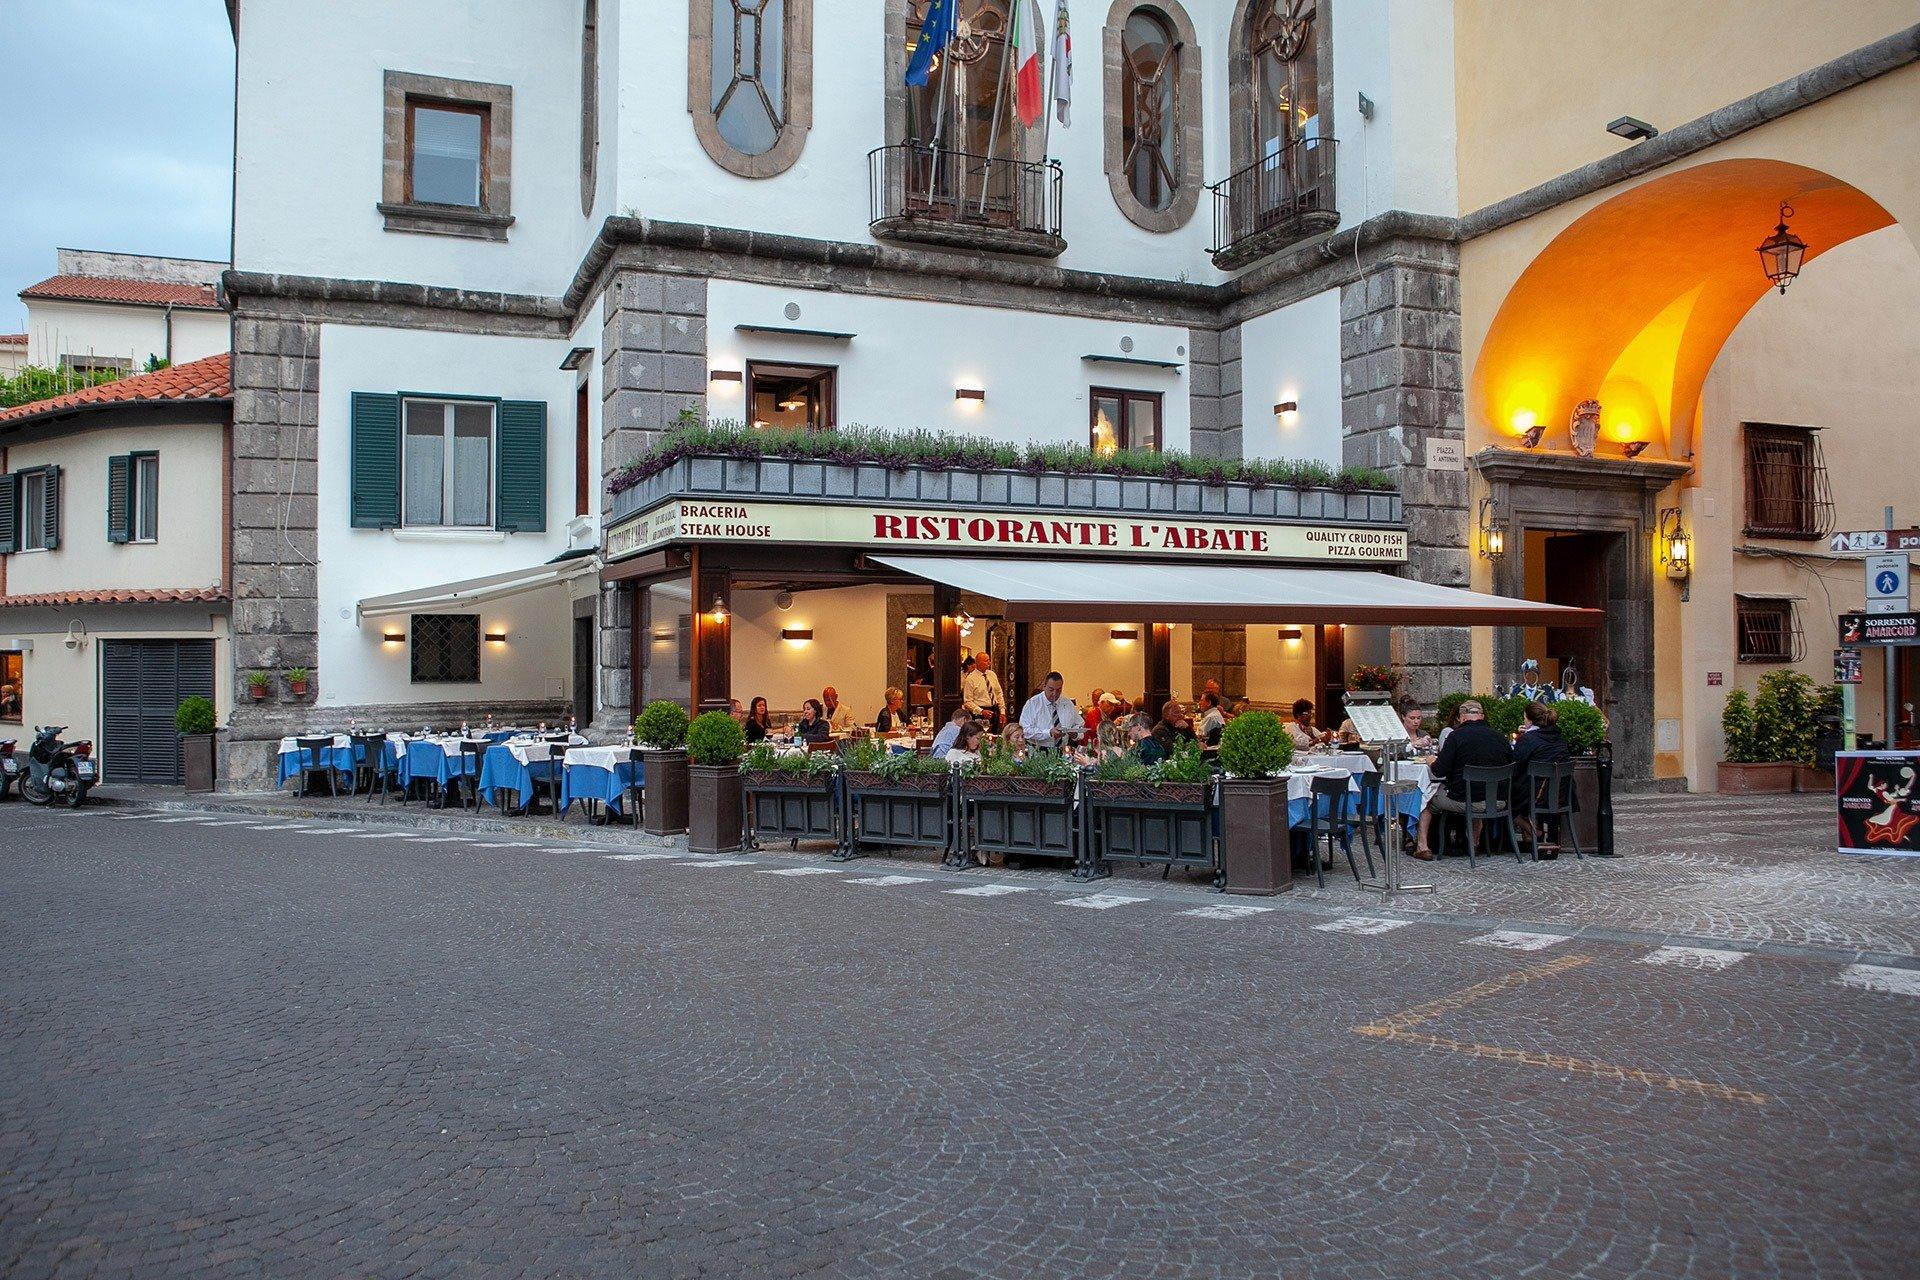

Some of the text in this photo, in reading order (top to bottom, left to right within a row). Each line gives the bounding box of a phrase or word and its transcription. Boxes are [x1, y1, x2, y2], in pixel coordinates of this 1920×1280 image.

[1436, 446, 1455, 454] PIAZZA
[681, 505, 748, 518] BRACERIA
[681, 523, 721, 536] STEAK
[725, 524, 771, 537] HOUSE
[873, 514, 1269, 552] RISTORANTE L'ABATE
[1306, 531, 1403, 545] QUALITY CRUDO FISH
[1328, 545, 1403, 558] PIZZA GOURMET
[1865, 618, 1916, 627] SORRENTO
[1865, 626, 1916, 637] AMARCORD
